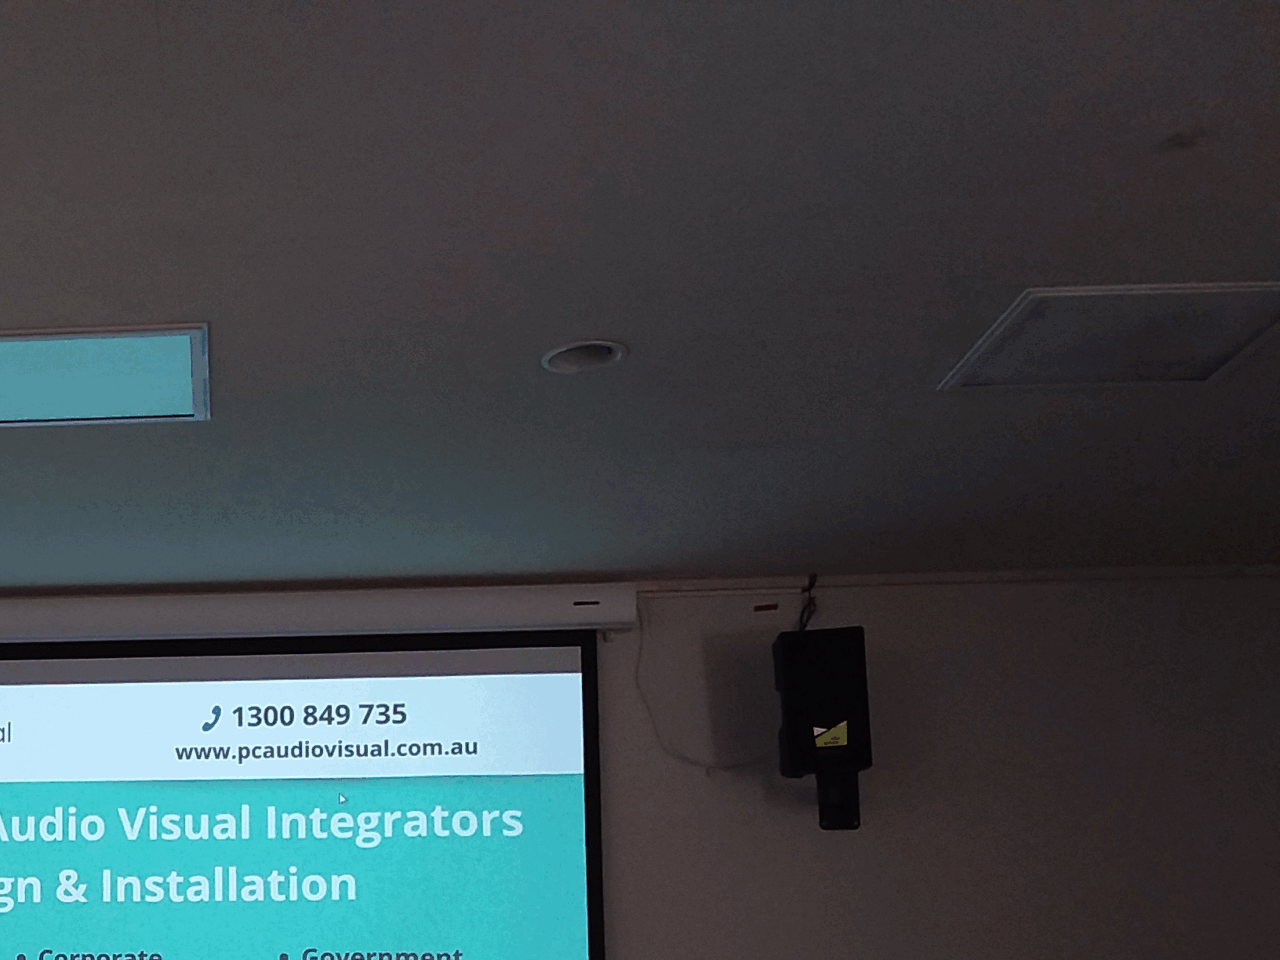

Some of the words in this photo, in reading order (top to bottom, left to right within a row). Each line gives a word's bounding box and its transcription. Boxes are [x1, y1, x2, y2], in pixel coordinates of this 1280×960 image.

[232, 705, 295, 727] 1300
[302, 704, 351, 726] 849
[358, 703, 408, 725] 735
[174, 739, 478, 764] www.pcaudiovisual.com.au
[117, 804, 250, 841] Visual
[266, 804, 524, 848] Integrators
[54, 869, 88, 903] &
[102, 866, 357, 902] Installation
